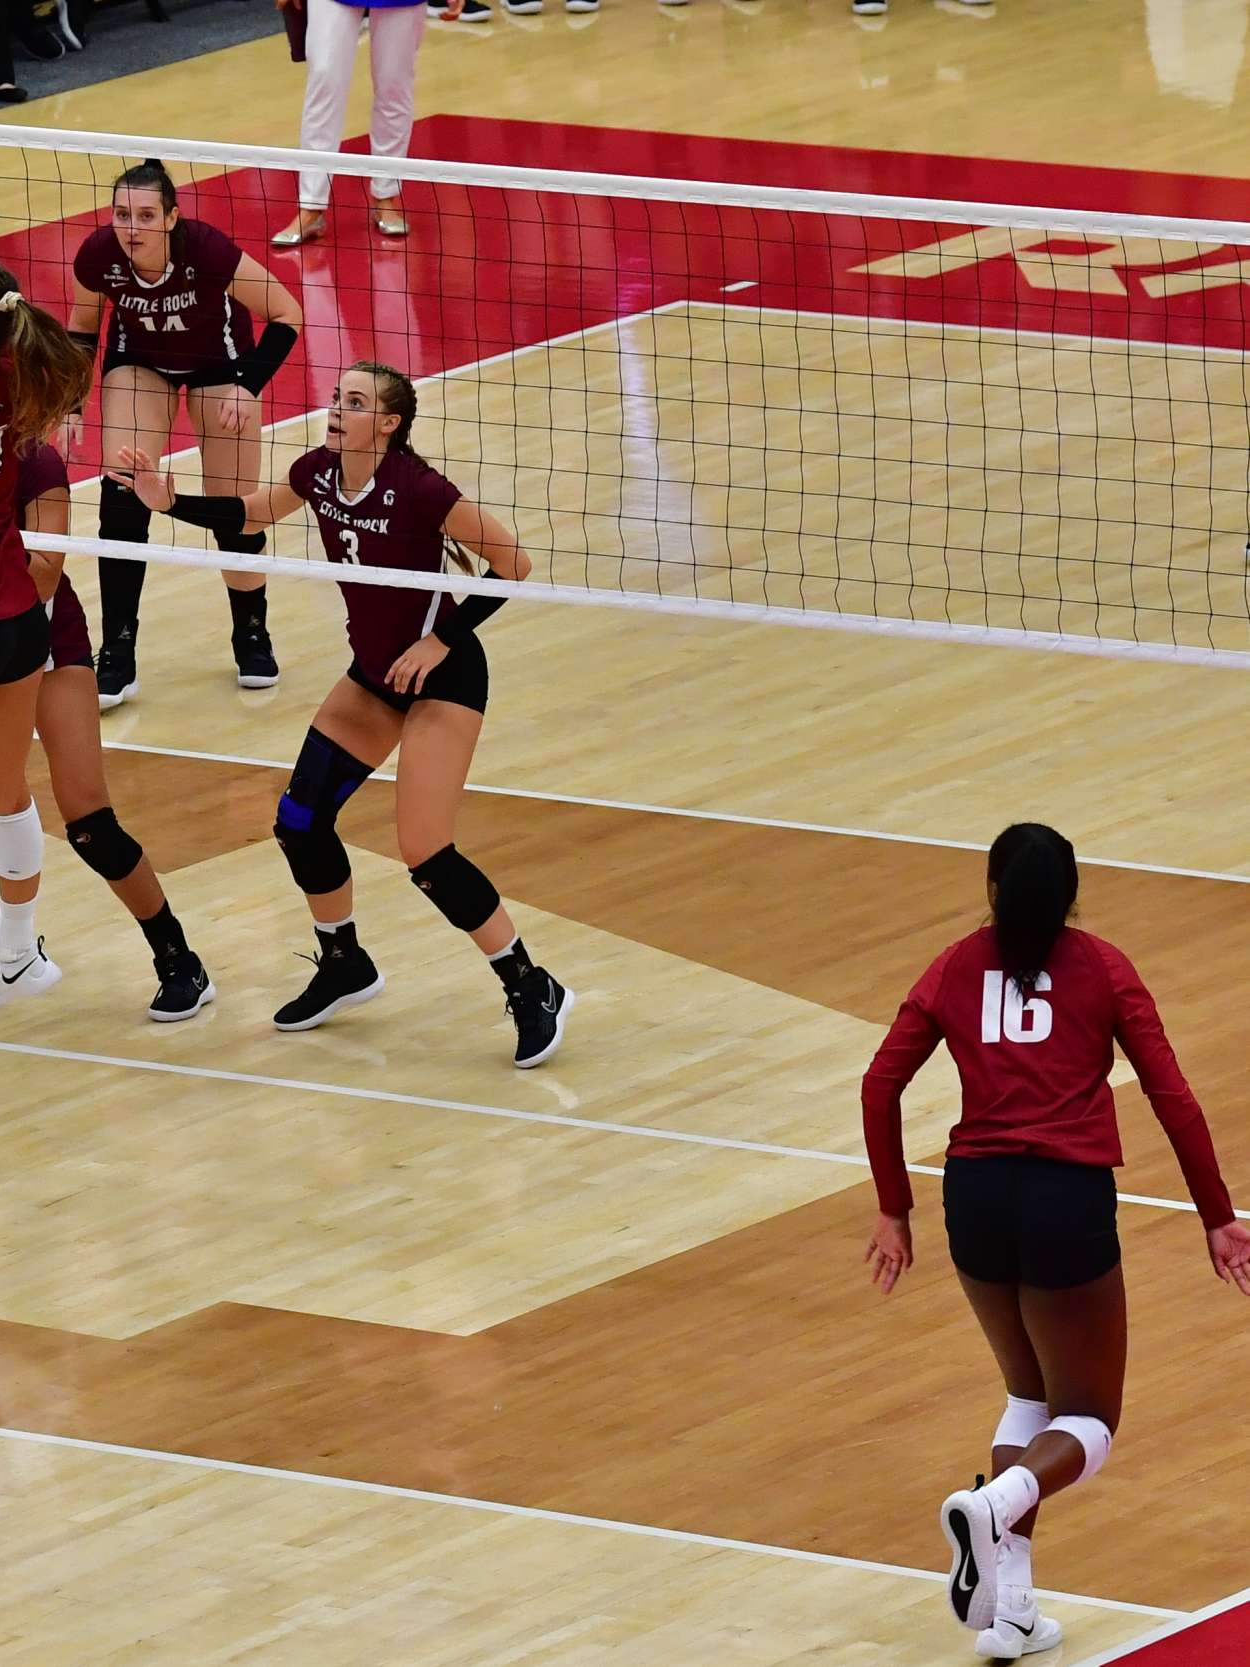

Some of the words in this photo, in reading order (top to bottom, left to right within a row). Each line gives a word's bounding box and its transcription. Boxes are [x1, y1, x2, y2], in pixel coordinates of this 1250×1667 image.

[118, 293, 159, 313] LITTLE
[163, 290, 198, 313] ROCK
[338, 529, 361, 566] 3
[981, 969, 1053, 1043] 16
